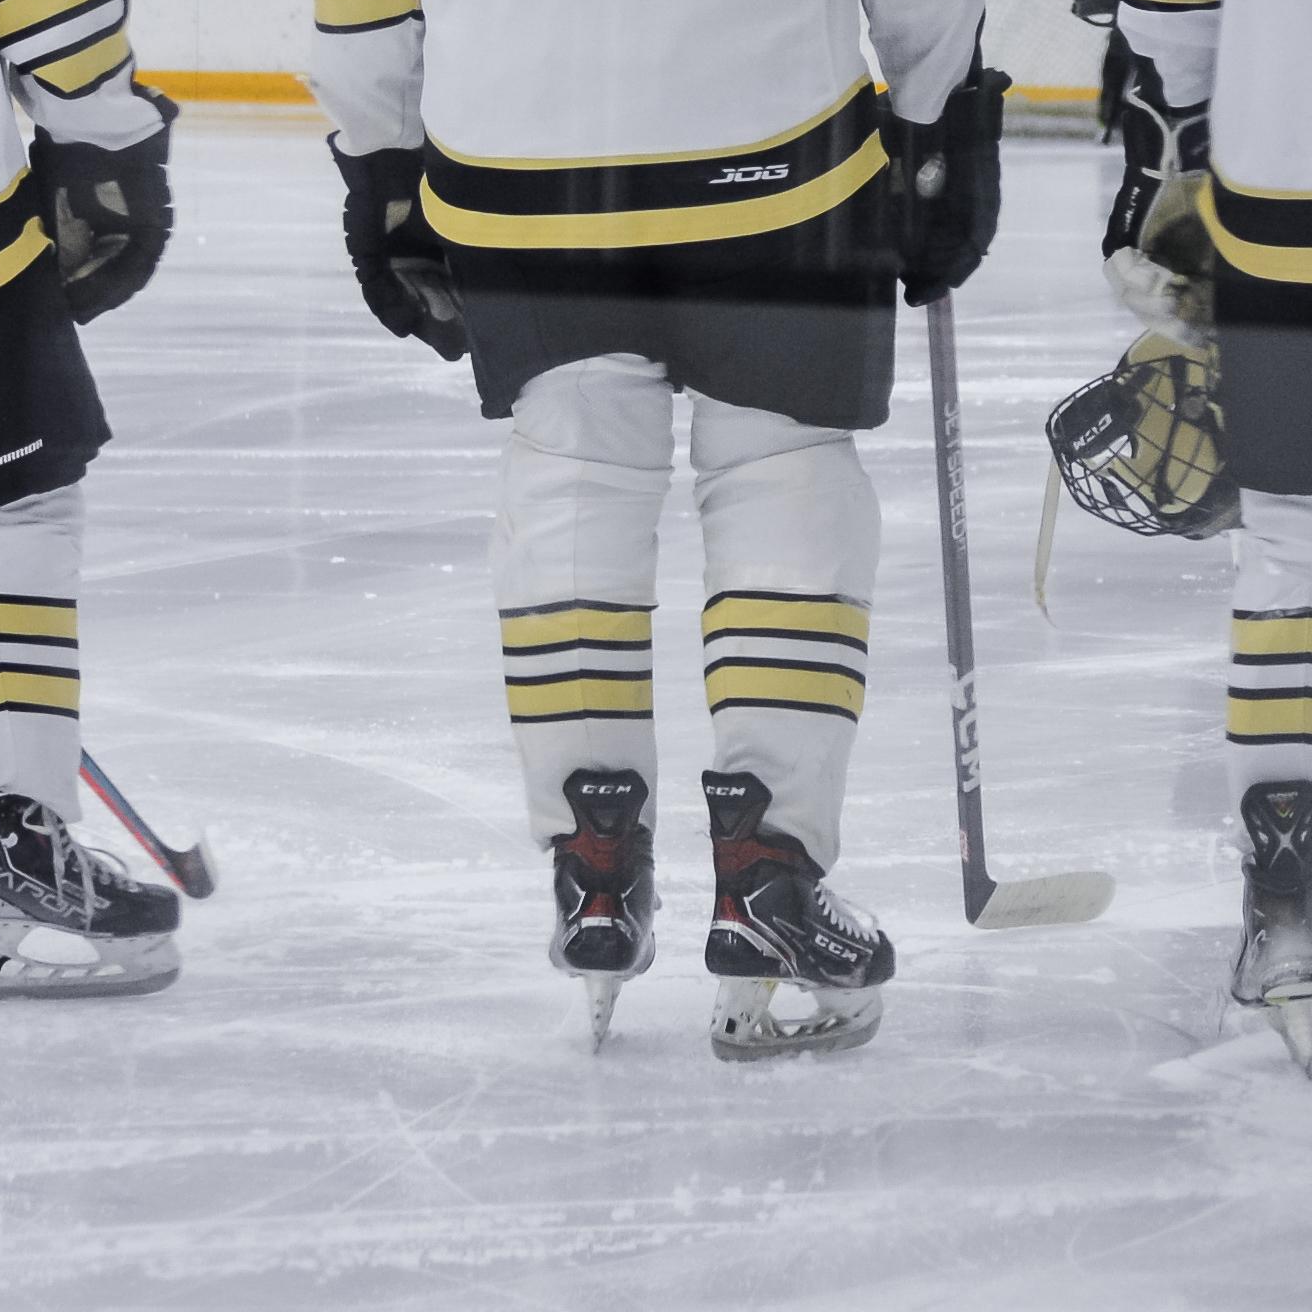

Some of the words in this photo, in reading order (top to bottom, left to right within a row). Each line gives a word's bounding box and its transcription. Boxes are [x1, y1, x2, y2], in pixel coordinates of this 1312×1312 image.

[709, 164, 789, 184] JOG
[582, 785, 631, 795] CCM
[706, 786, 746, 797] CCM
[815, 932, 857, 963] CCM
